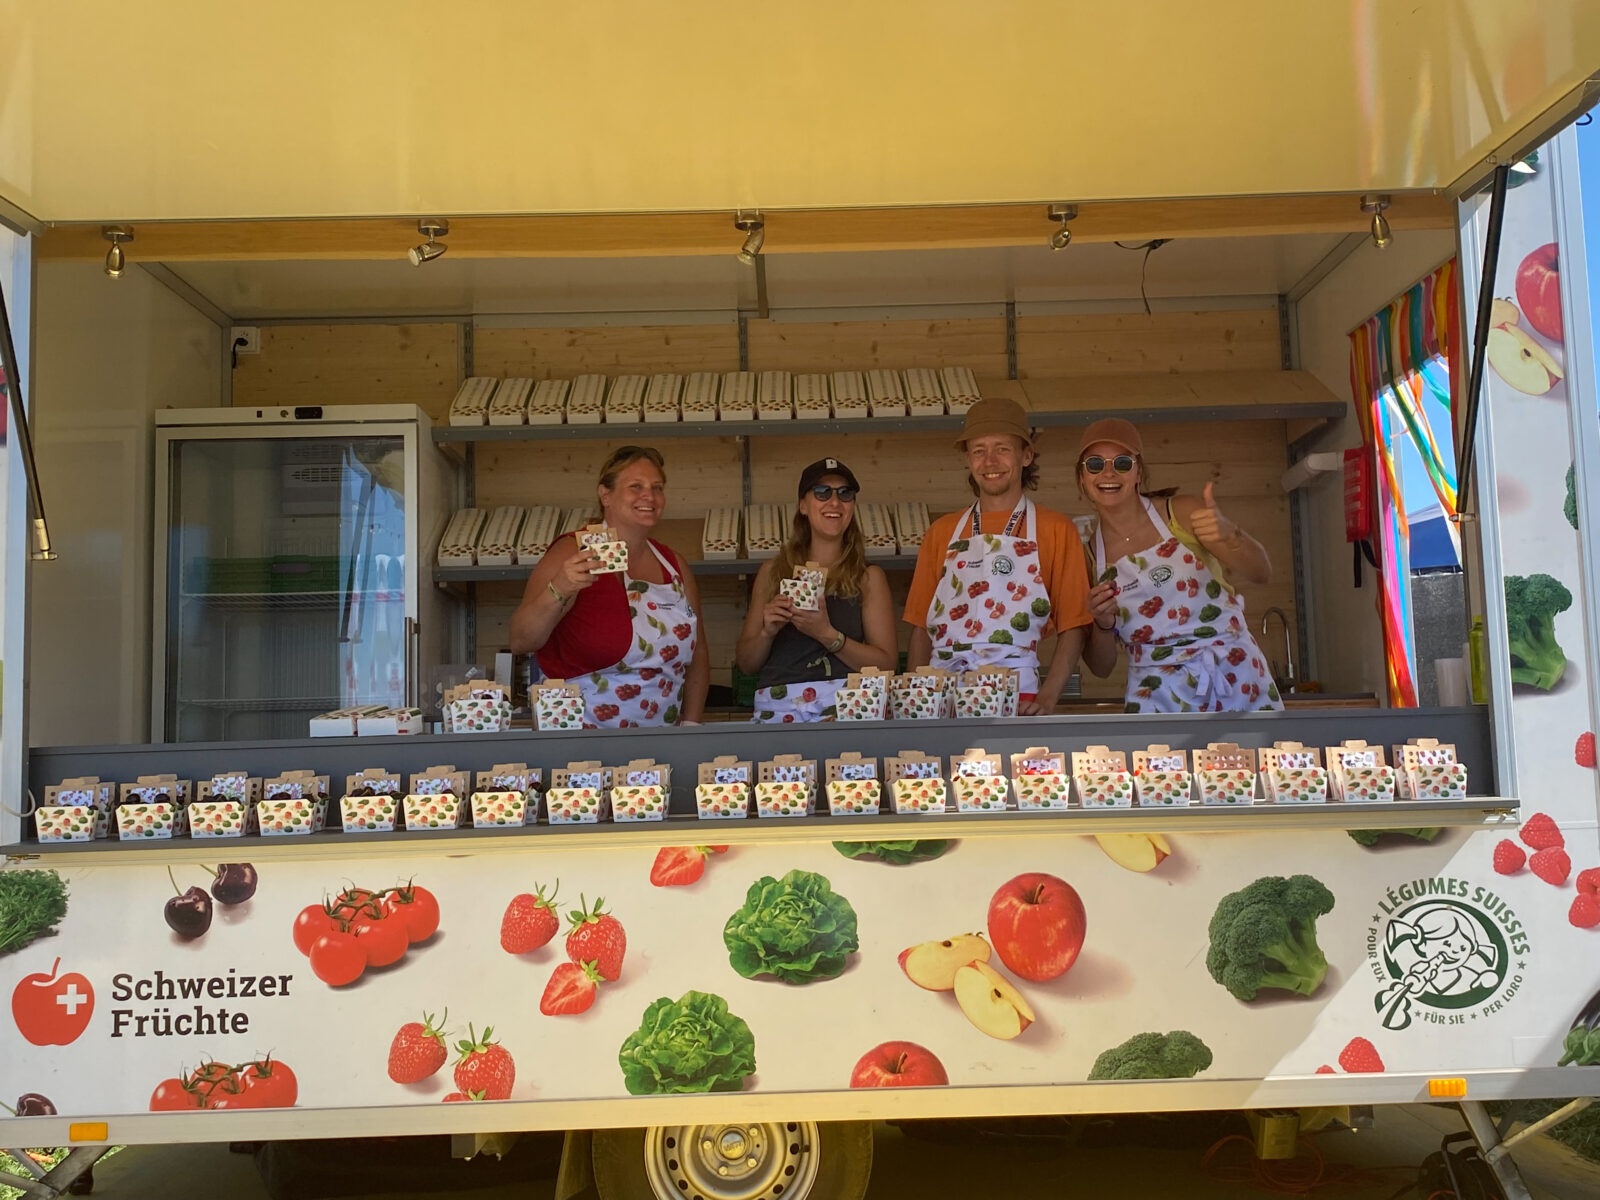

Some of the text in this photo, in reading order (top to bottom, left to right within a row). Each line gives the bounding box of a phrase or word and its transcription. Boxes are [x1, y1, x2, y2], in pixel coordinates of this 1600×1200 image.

[1378, 877, 1530, 955] LÉGUMES SUISSES
[1367, 927, 1387, 983] POUR EUX
[112, 968, 293, 1001] Schweizer
[1482, 975, 1522, 1017] PER LORO
[111, 1006, 249, 1037] Früchte
[1424, 1011, 1465, 1025] FÜR SIE
